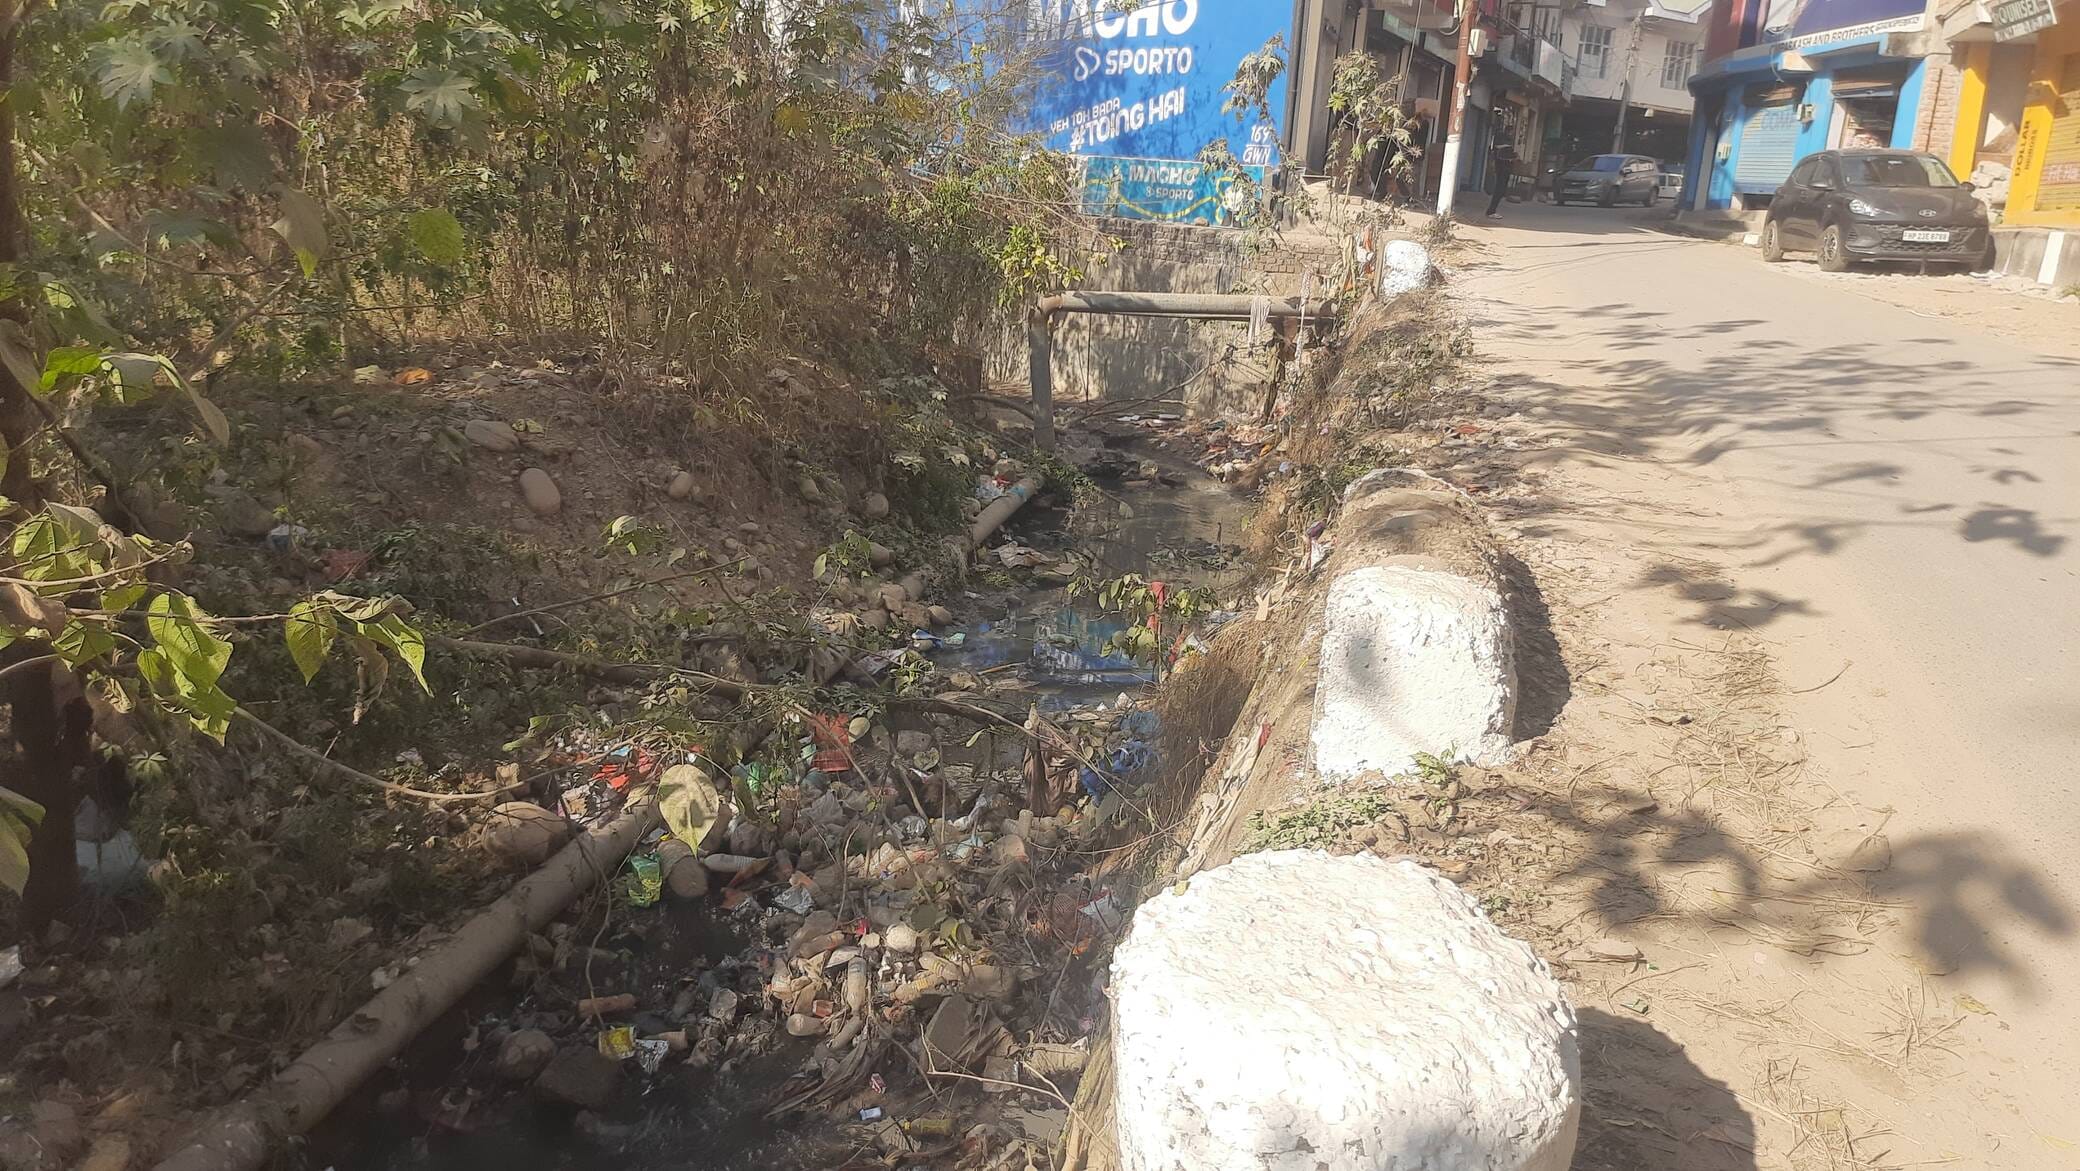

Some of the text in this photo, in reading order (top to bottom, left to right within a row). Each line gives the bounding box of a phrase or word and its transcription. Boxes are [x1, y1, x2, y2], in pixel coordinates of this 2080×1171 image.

[1105, 47, 1192, 75] SPORTO
[1050, 97, 1120, 134] YEH TOH BADA
[1148, 86, 1185, 125] HAI
[2014, 120, 2031, 177] DOLLAR
[1129, 164, 1199, 185] MACHO
[1155, 187, 1194, 199] SPORTO
